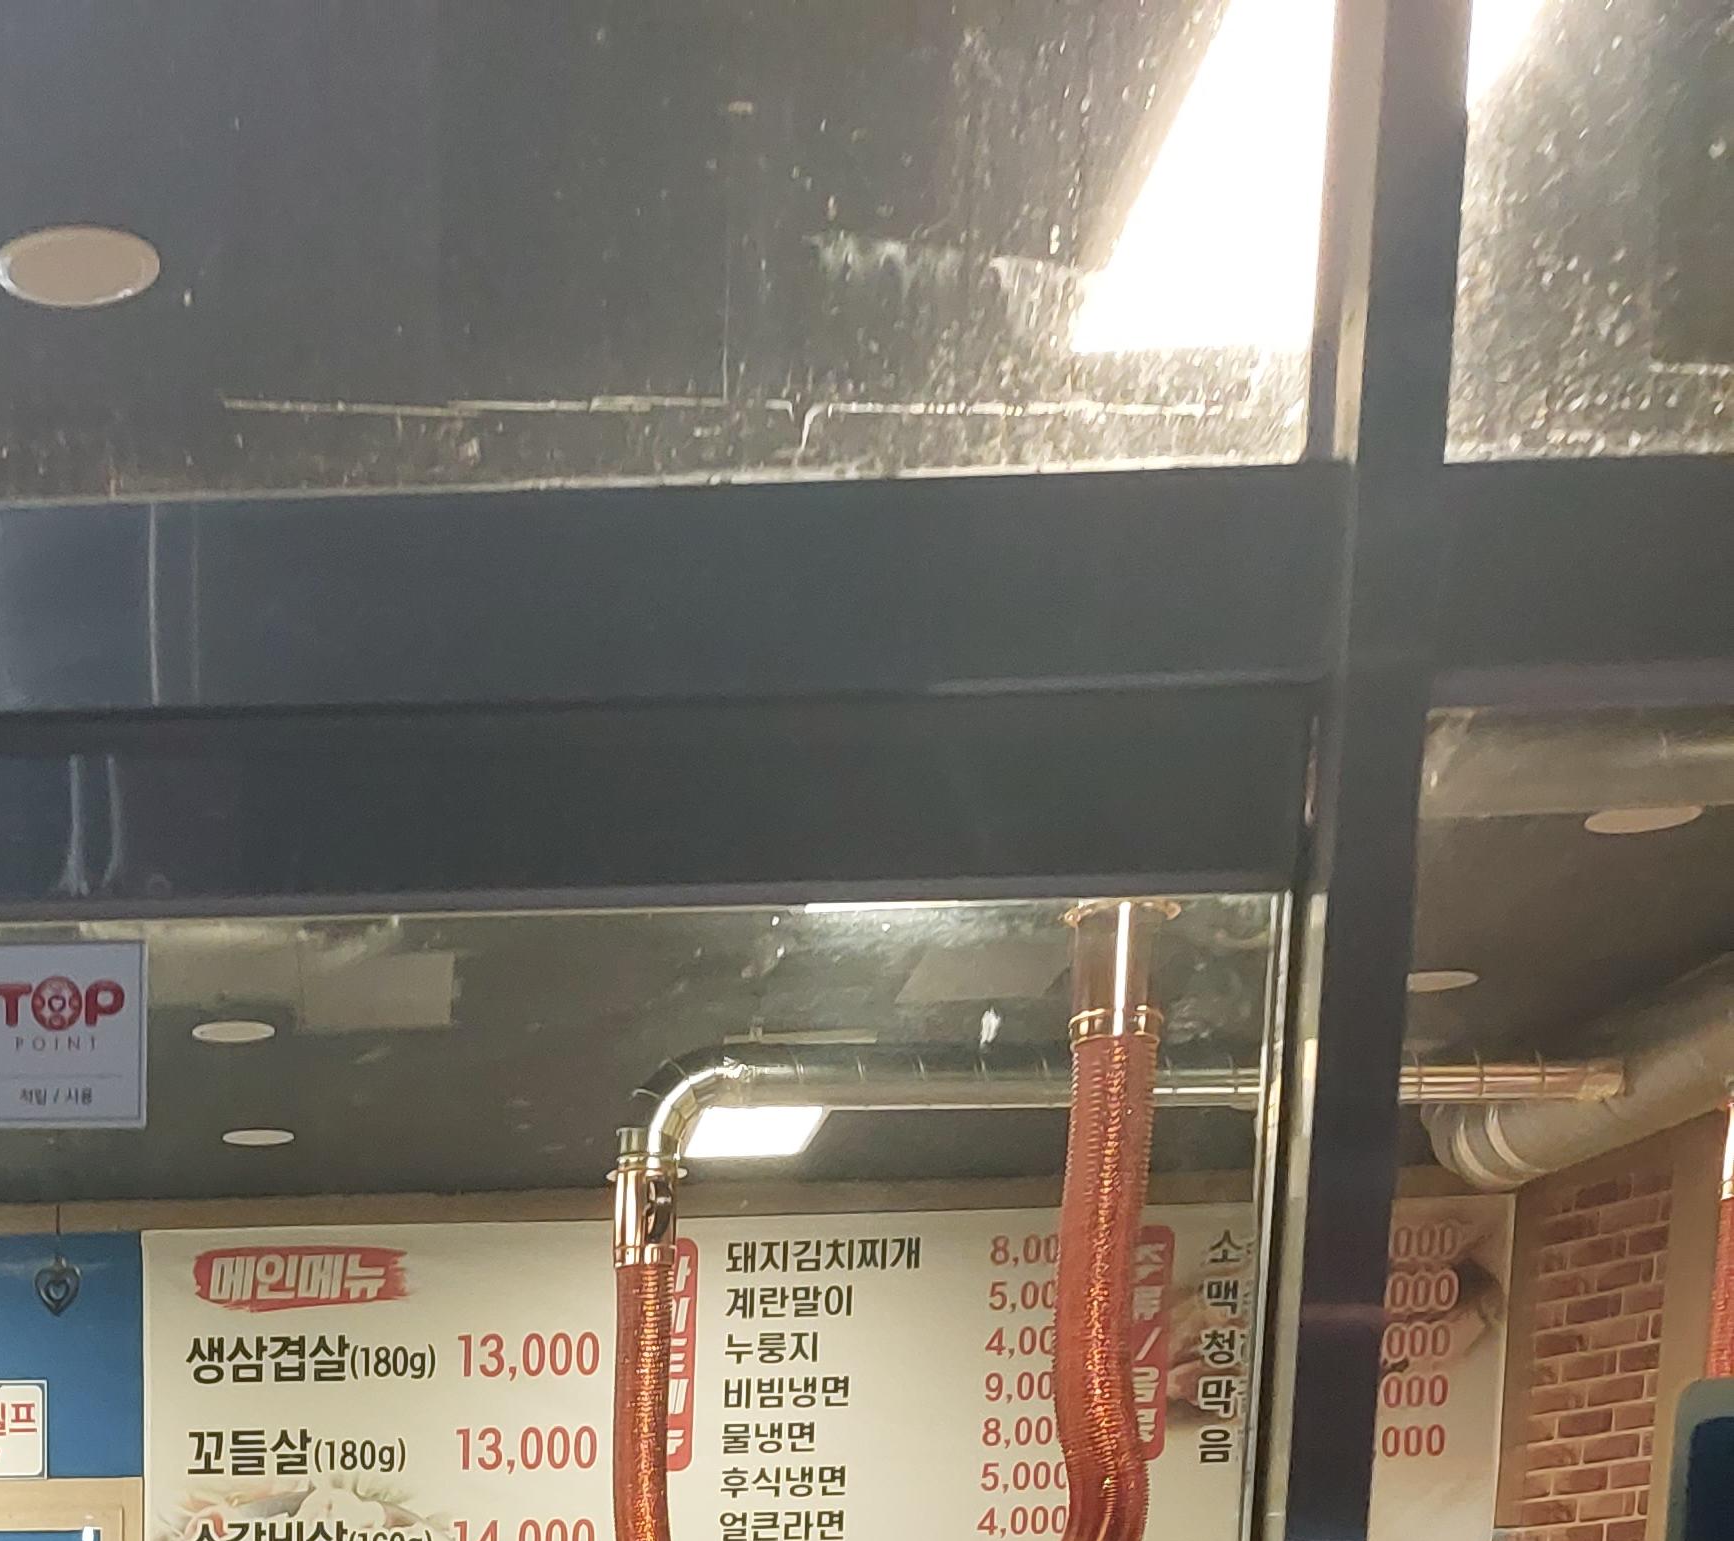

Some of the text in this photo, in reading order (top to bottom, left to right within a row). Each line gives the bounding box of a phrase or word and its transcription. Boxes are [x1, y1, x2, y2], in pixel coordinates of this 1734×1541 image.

[14, 1036, 98, 1053] POINT
[726, 1233, 1059, 1274] 돼지김치찌개 8,00
[209, 1253, 388, 1302] 메인메뉴
[725, 1280, 1055, 1319] 계란말이 5,00
[457, 1331, 600, 1382] 13,000
[724, 1325, 1056, 1364] 누룽지 4,00
[723, 1370, 1054, 1410] 비빔냉면 9,00
[455, 1425, 598, 1475] 13,000
[721, 1415, 1053, 1455] 물냉면 8,00
[720, 1466, 847, 1499] 후식냉면
